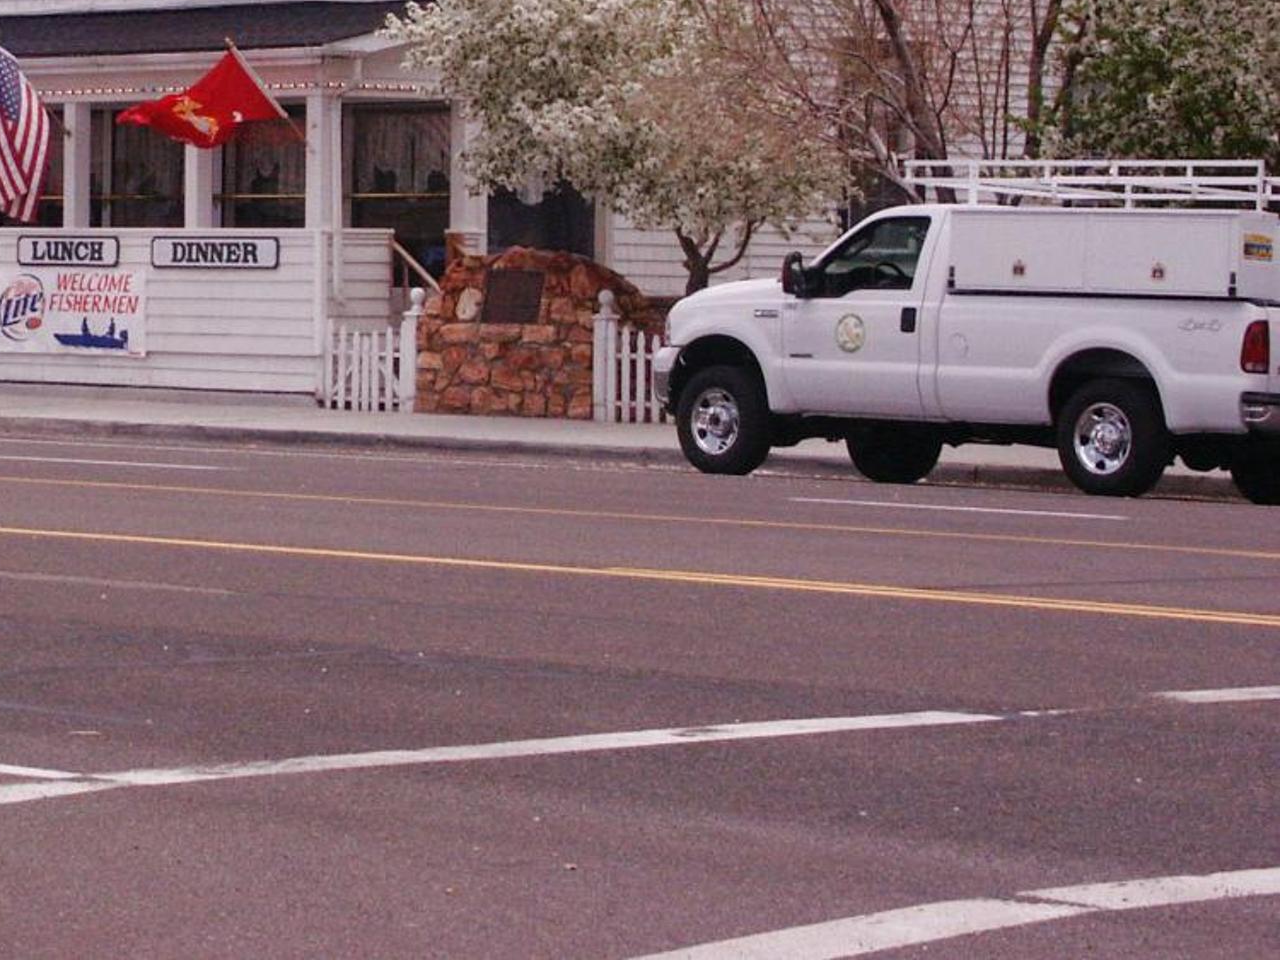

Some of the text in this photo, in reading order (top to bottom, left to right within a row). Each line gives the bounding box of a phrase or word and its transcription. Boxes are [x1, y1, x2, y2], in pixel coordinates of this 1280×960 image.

[31, 240, 104, 262] LUNCH
[171, 241, 259, 264] DINNER
[57, 273, 134, 293] WELCOME
[49, 292, 140, 315] FISHERMEN
